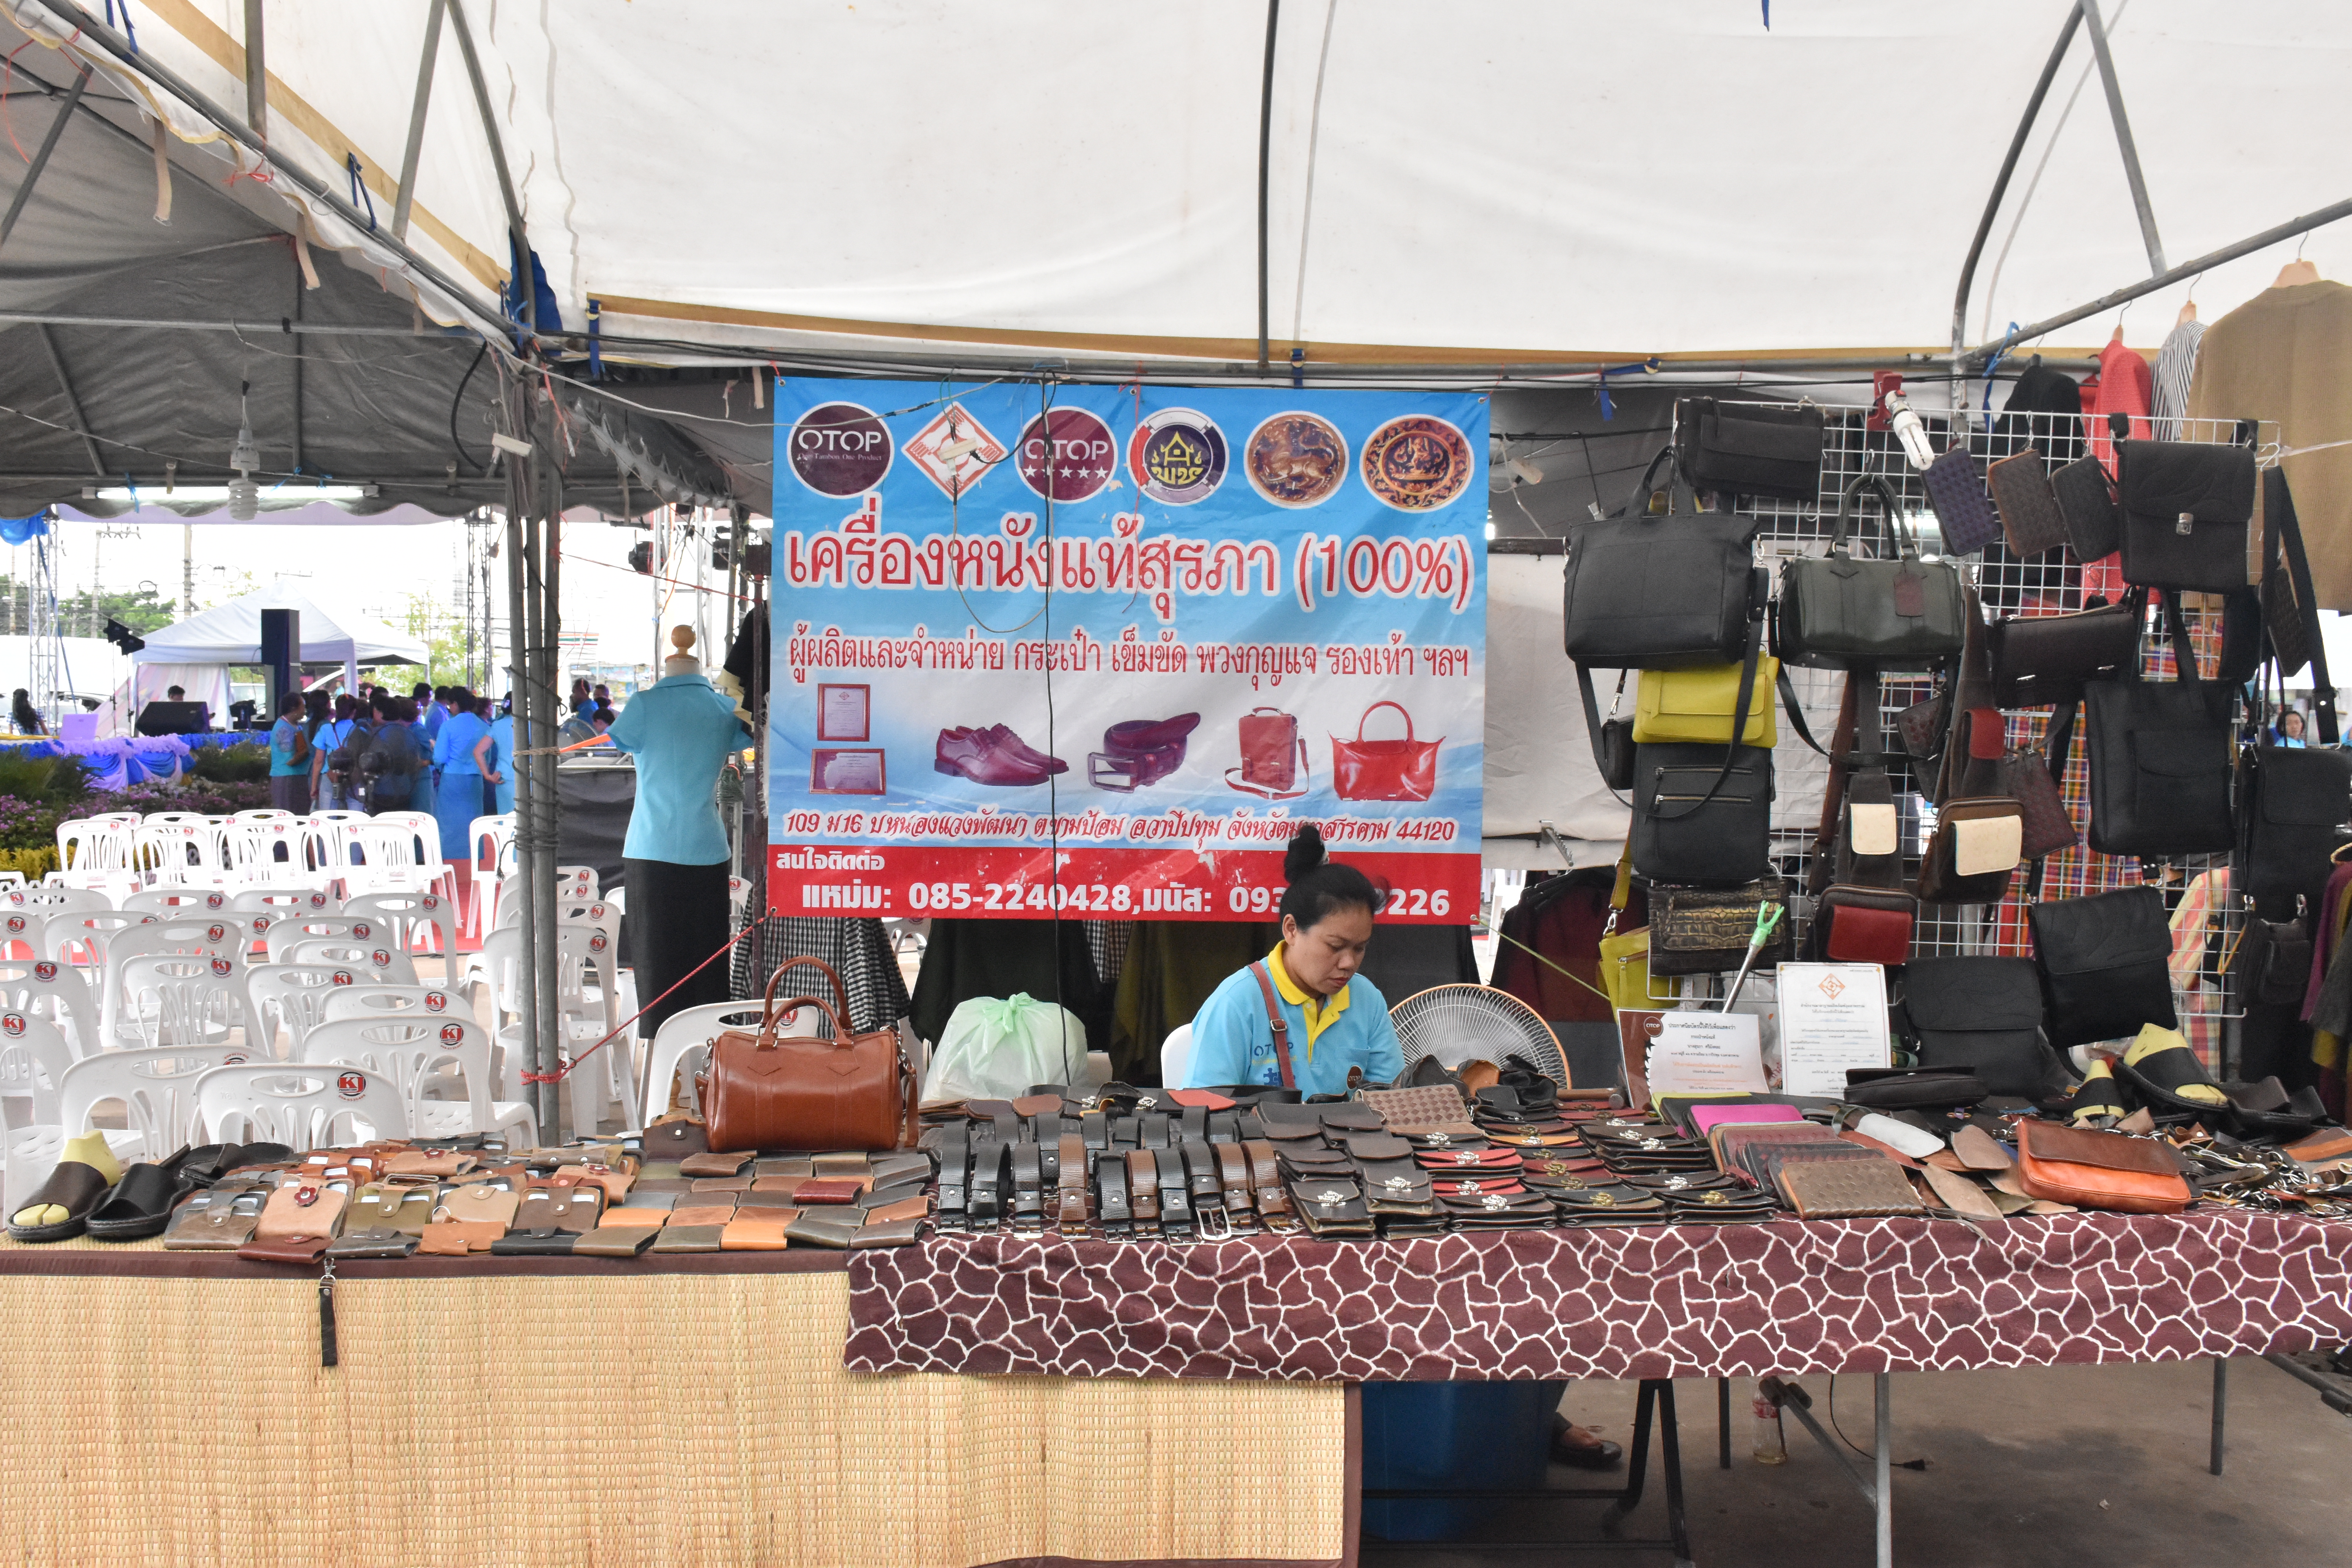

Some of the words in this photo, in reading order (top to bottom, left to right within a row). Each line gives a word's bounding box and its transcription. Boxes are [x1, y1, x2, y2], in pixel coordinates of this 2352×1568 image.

[798, 430, 882, 452] OTOP
[1025, 439, 1109, 460] OTOP
[790, 497, 1274, 619] เครื่องหนังแท้สุรภา
[1299, 535, 1471, 610] (100%)
[790, 623, 1004, 683] ผู้ผลิตและจำหน่าย
[1014, 628, 1101, 671] กระเป๋า
[1112, 627, 1187, 673] เข็มขัด
[1196, 645, 1317, 691] พวงกุญแจ
[1326, 633, 1414, 675] รองเท้า
[1423, 648, 1468, 676] ฯลฯ
[787, 813, 820, 833] 109
[827, 814, 863, 833] ม.16
[1129, 810, 1224, 850] อ.วาปีปทุม
[1396, 821, 1455, 841] 44120
[776, 847, 885, 870] สนใจติดต่อ
[802, 879, 891, 909] แหม่ม:
[208, 897, 223, 906] KJ
[311, 896, 326, 905] KJ
[423, 898, 437, 907] KJ
[591, 907, 604, 917] KJ
[8, 919, 24, 930] KJ
[253, 920, 269, 930] KJ
[209, 927, 224, 938] KJ
[354, 927, 370, 936] KJ
[591, 938, 606, 949] KJ
[373, 952, 390, 964] KJ
[36, 965, 56, 976] KJ
[212, 960, 230, 972] KJ
[334, 975, 351, 985] KJ
[426, 996, 445, 1009] KJ
[3, 1017, 24, 1032] KJ
[441, 1027, 463, 1042] KJ
[1254, 1042, 1294, 1056] OTP
[338, 1076, 364, 1093] KJ
